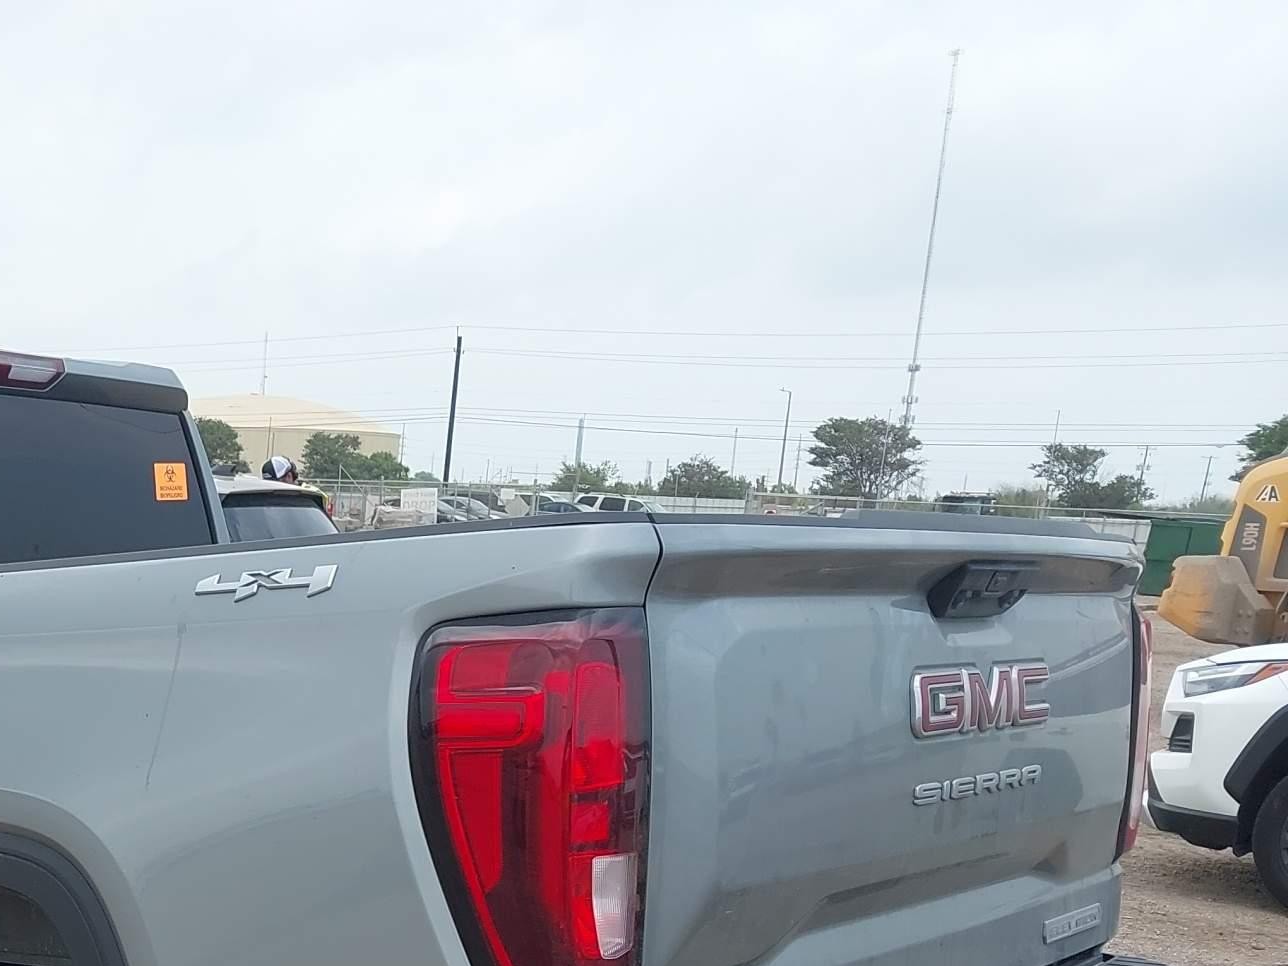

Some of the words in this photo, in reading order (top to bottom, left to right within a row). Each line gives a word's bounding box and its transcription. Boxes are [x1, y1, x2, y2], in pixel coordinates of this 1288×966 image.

[1240, 522, 1261, 551] L90H
[911, 664, 1050, 739] GMC
[913, 764, 1043, 806] SIERRA
